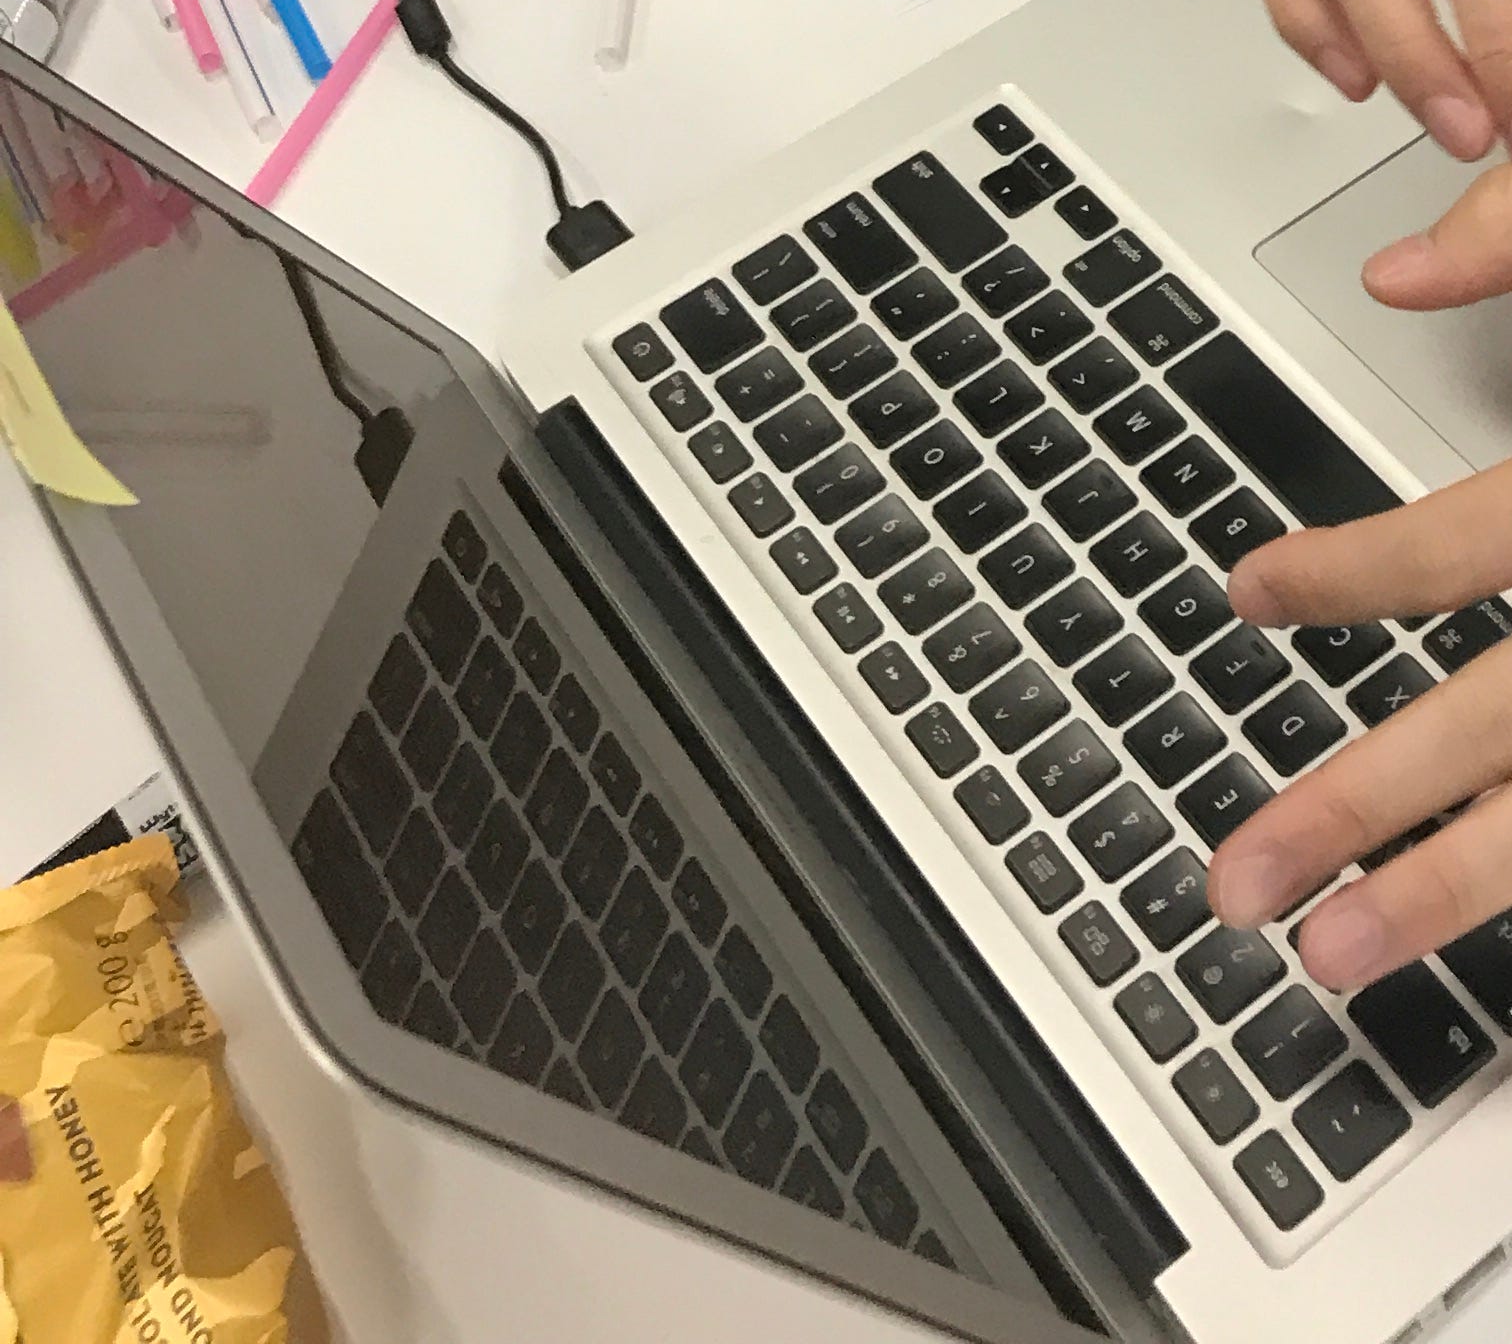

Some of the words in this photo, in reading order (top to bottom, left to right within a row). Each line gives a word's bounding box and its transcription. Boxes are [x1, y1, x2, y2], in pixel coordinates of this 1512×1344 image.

[1112, 235, 1142, 263] option
[1156, 282, 1204, 325] command
[989, 386, 1008, 404] L
[881, 402, 903, 415] P
[1126, 410, 1152, 433] M
[1029, 435, 1054, 455] K
[923, 447, 945, 465] O
[1173, 463, 1199, 484] N
[1077, 490, 1099, 504] J
[1226, 517, 1248, 536] B
[1123, 540, 1149, 562] H
[1011, 554, 1035, 575] U
[927, 571, 947, 588] 8
[1174, 598, 1197, 617] G
[1059, 612, 1082, 631] Y
[971, 630, 993, 645] 7
[1329, 627, 1352, 647] C
[1225, 659, 1249, 676] F
[1108, 670, 1131, 688] T
[1020, 686, 1040, 701] 6
[1384, 684, 1411, 710] X
[1281, 716, 1306, 737] D
[1161, 726, 1185, 748] R
[1068, 747, 1090, 764] 5
[1214, 789, 1239, 810] E
[1175, 874, 1197, 895] 3
[96, 930, 129, 948] g
[97, 955, 139, 1013] 200
[45, 1083, 104, 1185] HONEY
[87, 1184, 131, 1263] WITH
[133, 1182, 181, 1291] NOUGAT
[117, 1255, 169, 1344] OLATE
